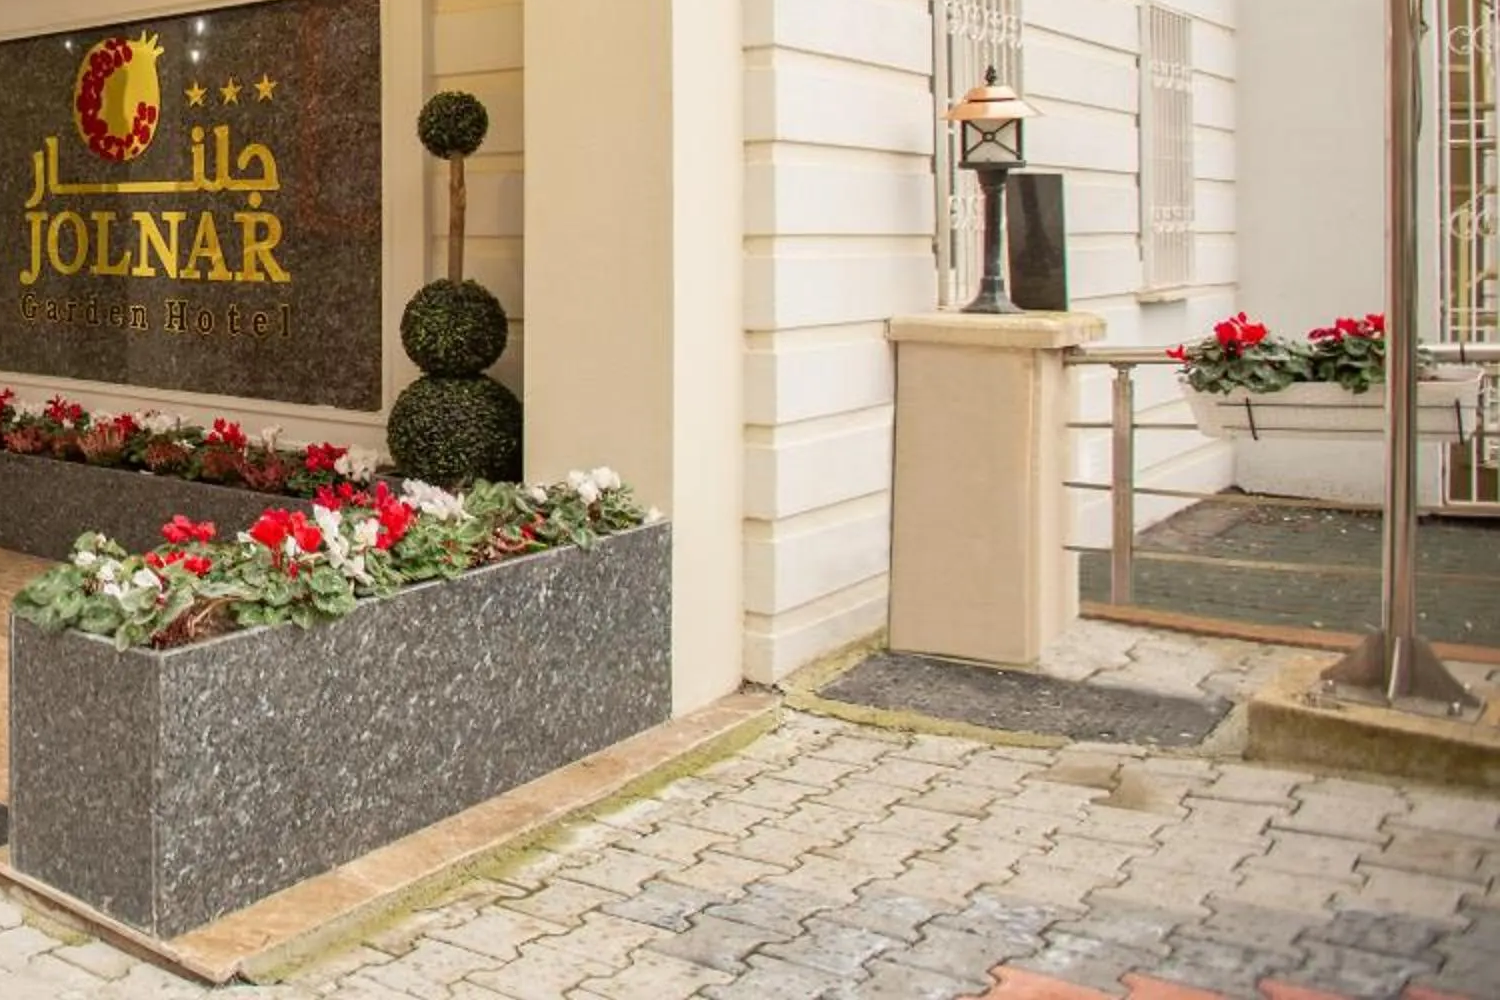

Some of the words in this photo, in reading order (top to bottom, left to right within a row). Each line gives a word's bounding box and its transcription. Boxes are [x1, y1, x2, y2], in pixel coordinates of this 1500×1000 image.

[19, 211, 291, 285] JOLNAR
[20, 291, 148, 331] Garden
[164, 299, 291, 338] Hotel
